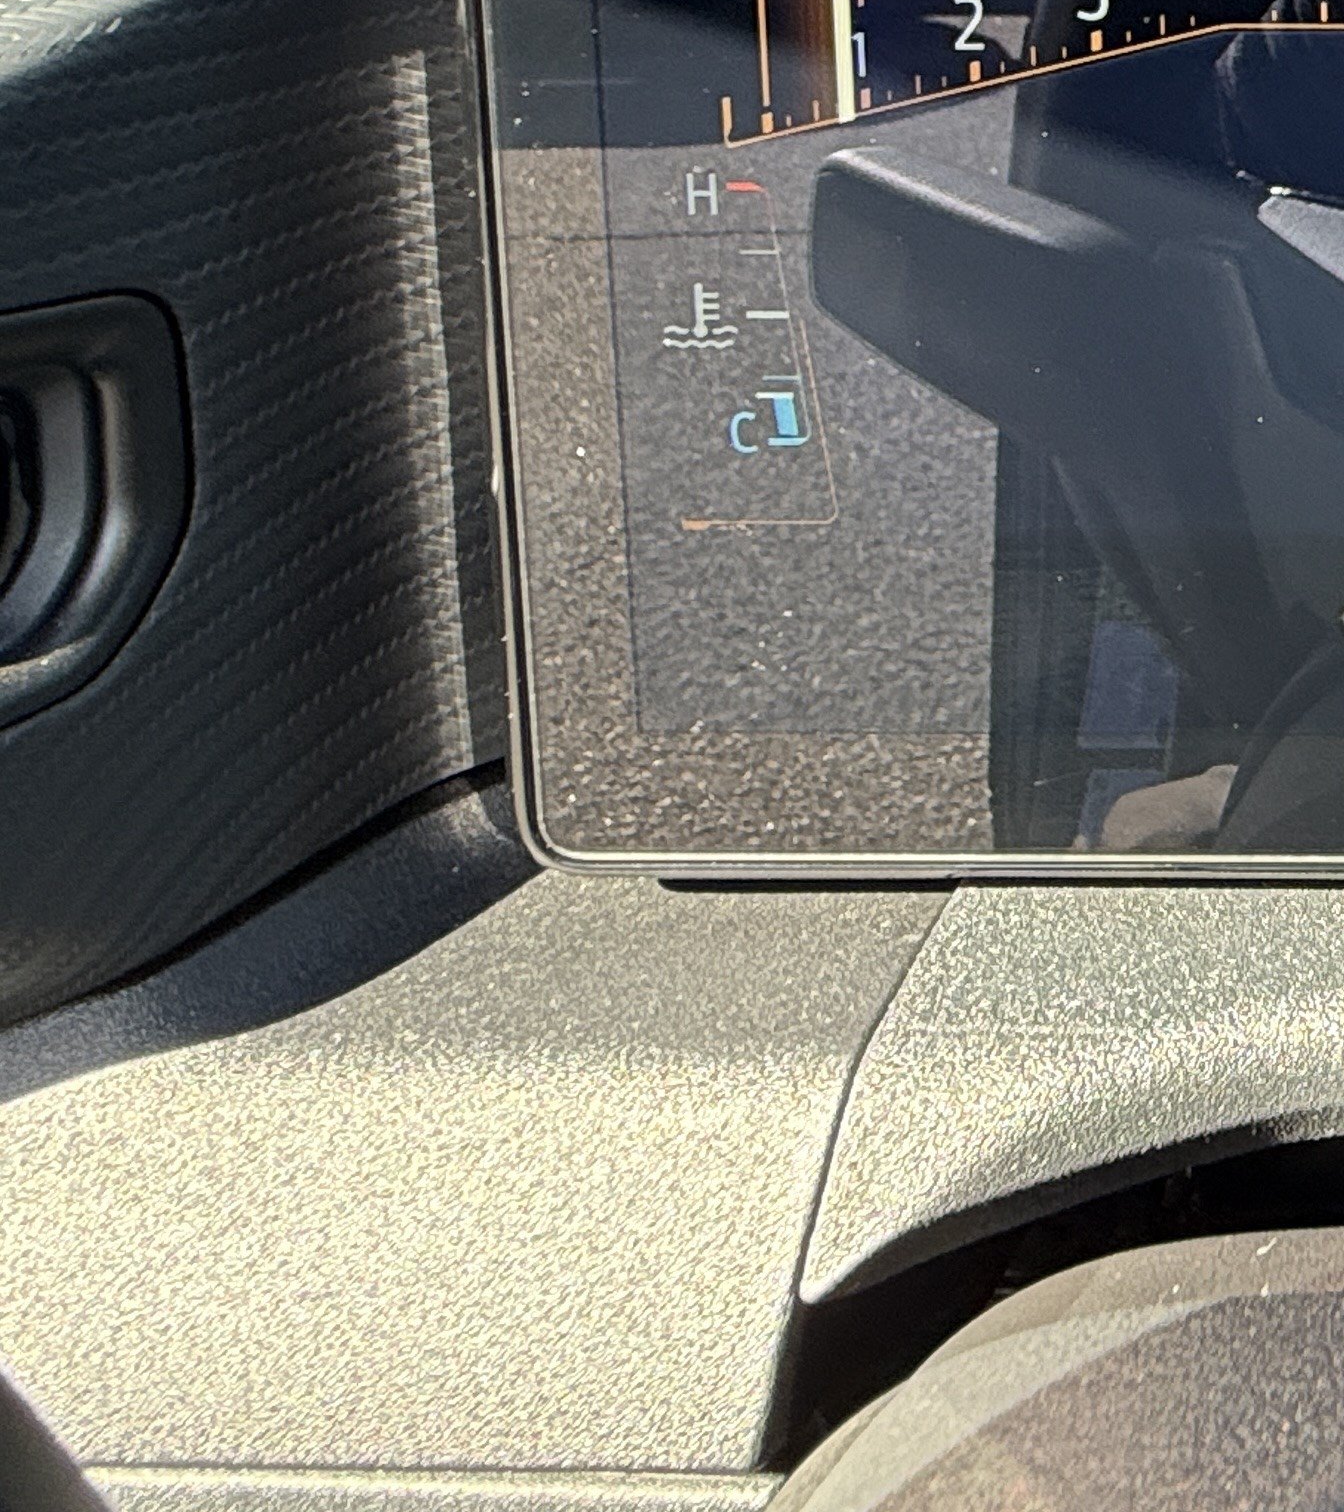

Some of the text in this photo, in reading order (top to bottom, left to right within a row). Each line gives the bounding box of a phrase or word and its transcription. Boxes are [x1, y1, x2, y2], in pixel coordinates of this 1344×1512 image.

[850, 31, 867, 78] 1
[686, 172, 718, 216] H
[730, 411, 759, 454] C
